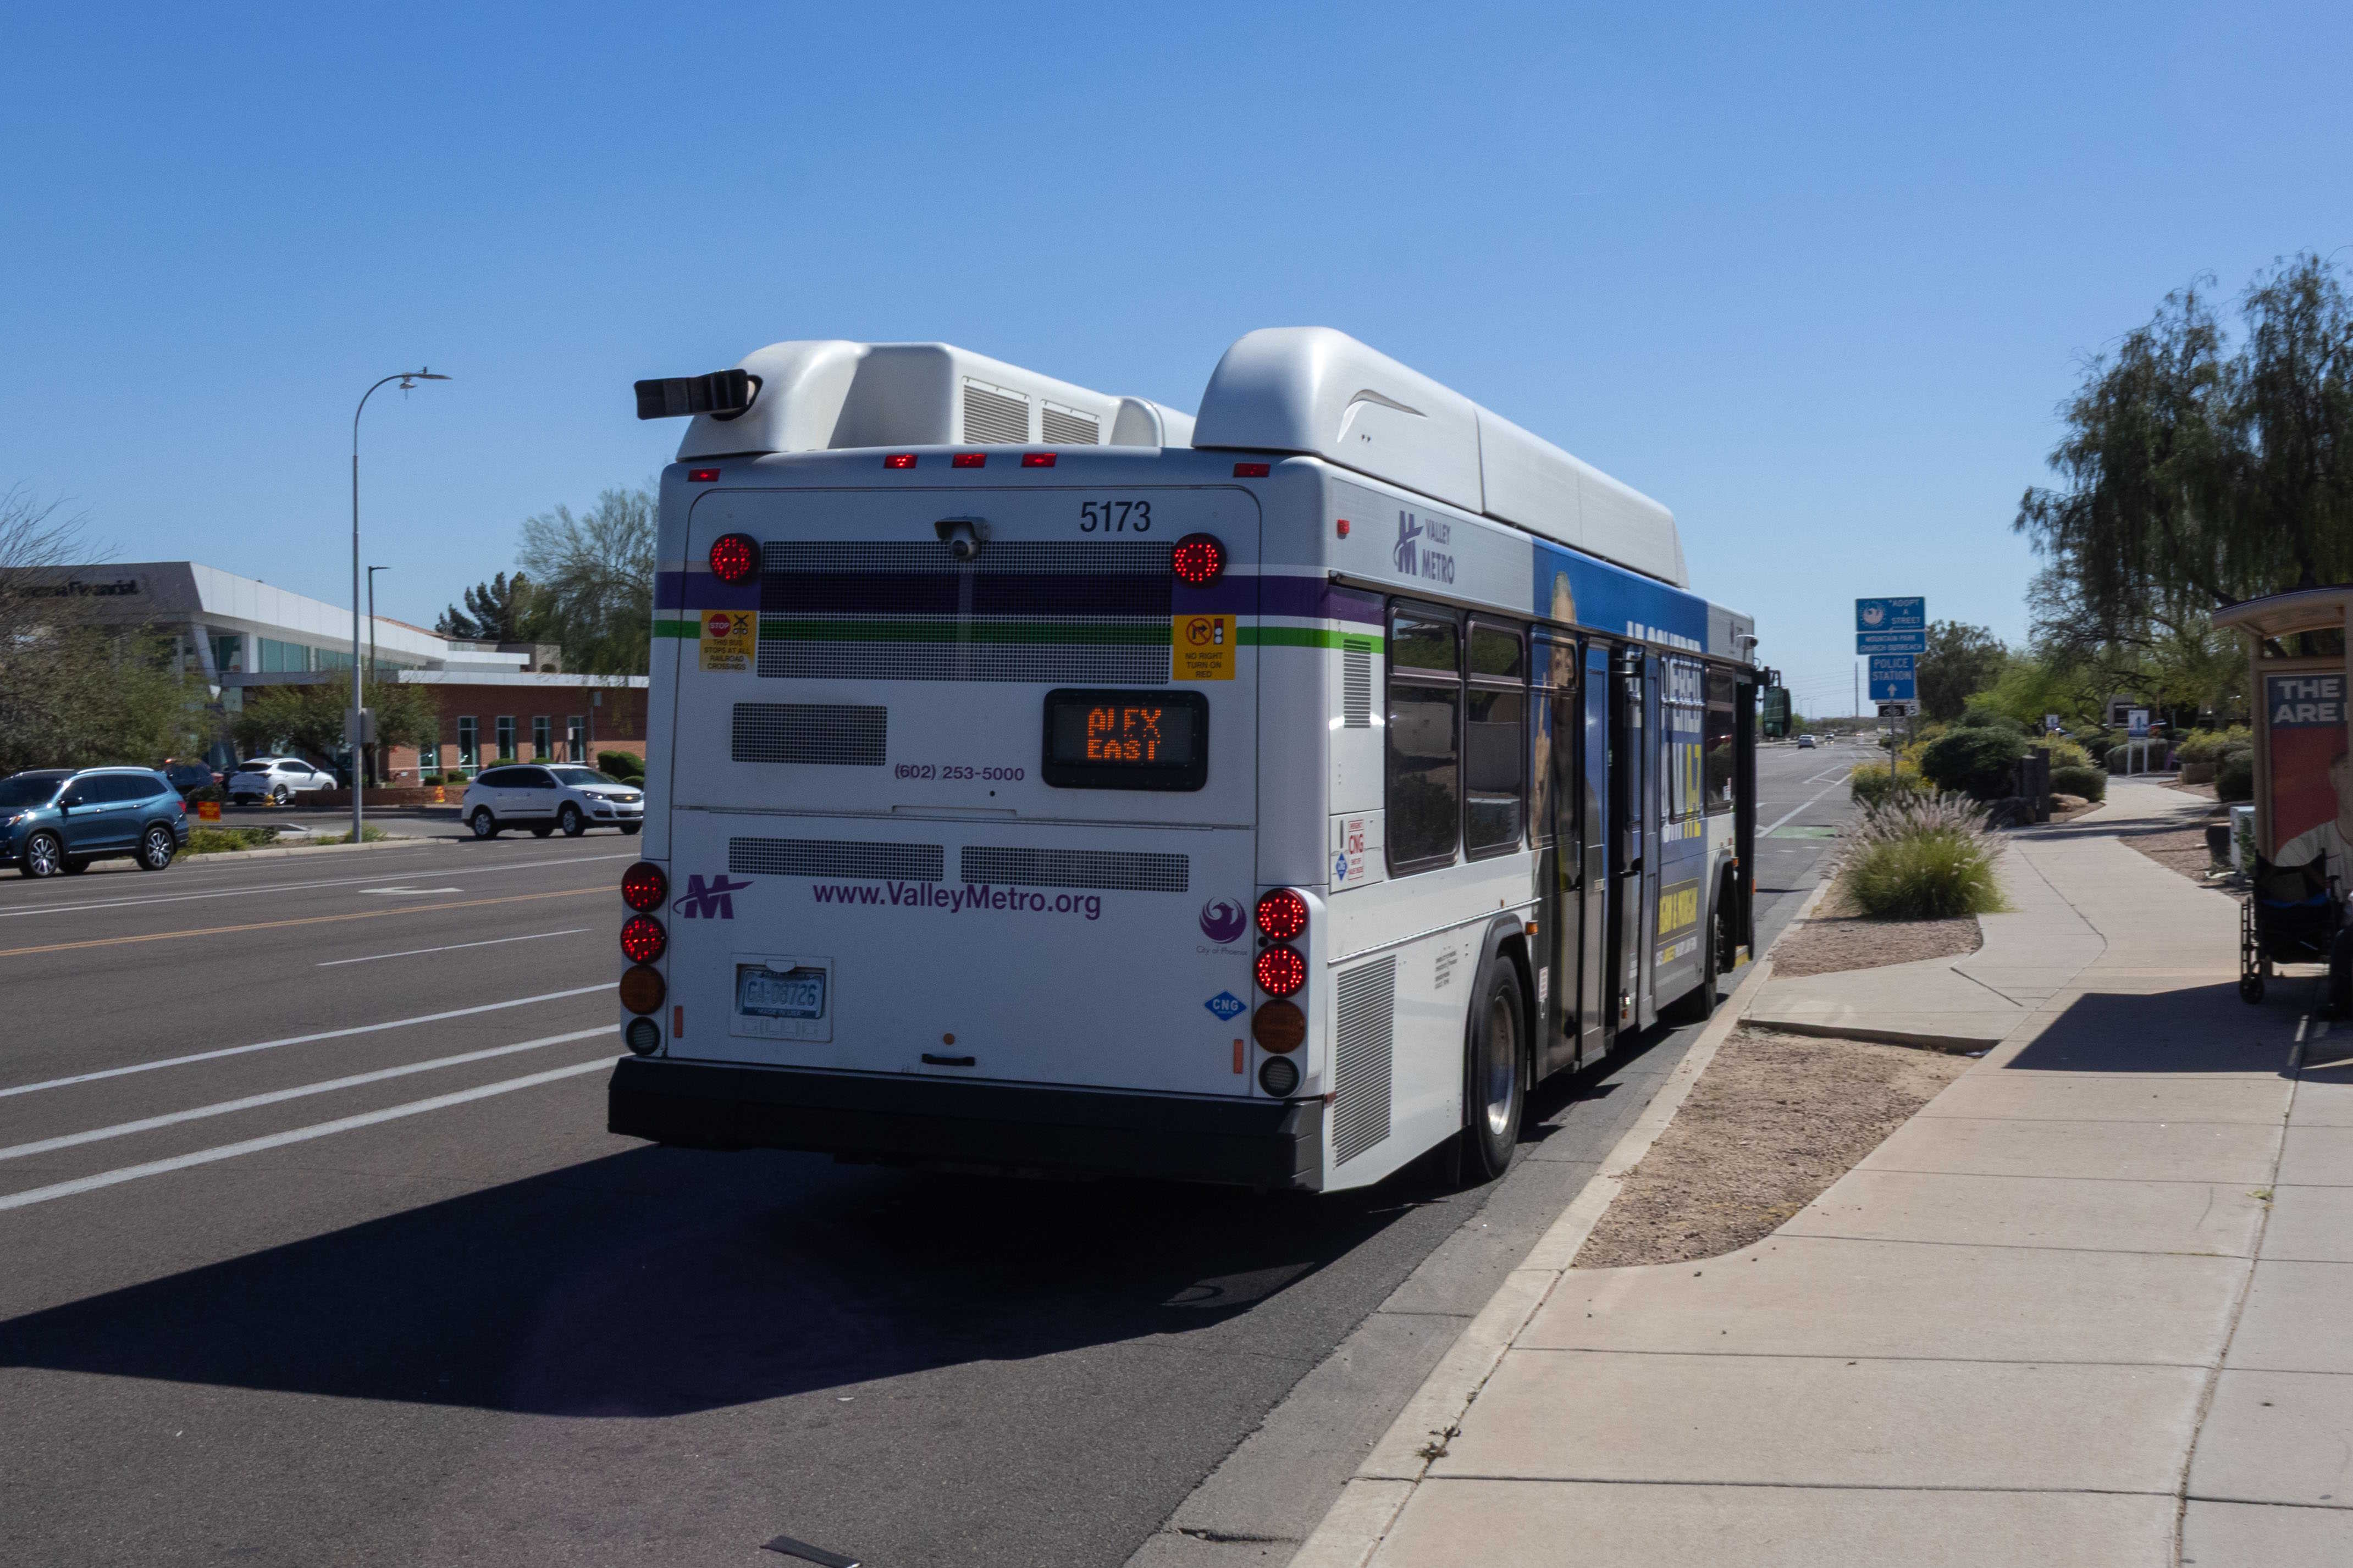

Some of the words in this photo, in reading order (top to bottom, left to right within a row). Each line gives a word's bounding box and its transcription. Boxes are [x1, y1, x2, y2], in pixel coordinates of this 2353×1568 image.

[1079, 501, 1151, 532] 5173
[1425, 518, 1451, 545] VALLEY
[1422, 548, 1455, 585] METRO
[1891, 617, 1921, 625] STREET
[1874, 658, 1909, 669] POLICE
[1872, 670, 1912, 682] STATION
[2277, 679, 2340, 700] THE
[2272, 702, 2338, 723] ARE
[895, 763, 936, 780] (602)
[942, 766, 1025, 782] 253-5000
[1349, 834, 1363, 854] CNG
[813, 880, 1101, 921] www.ValleyMetro.org
[1212, 999, 1239, 1011] CNG
